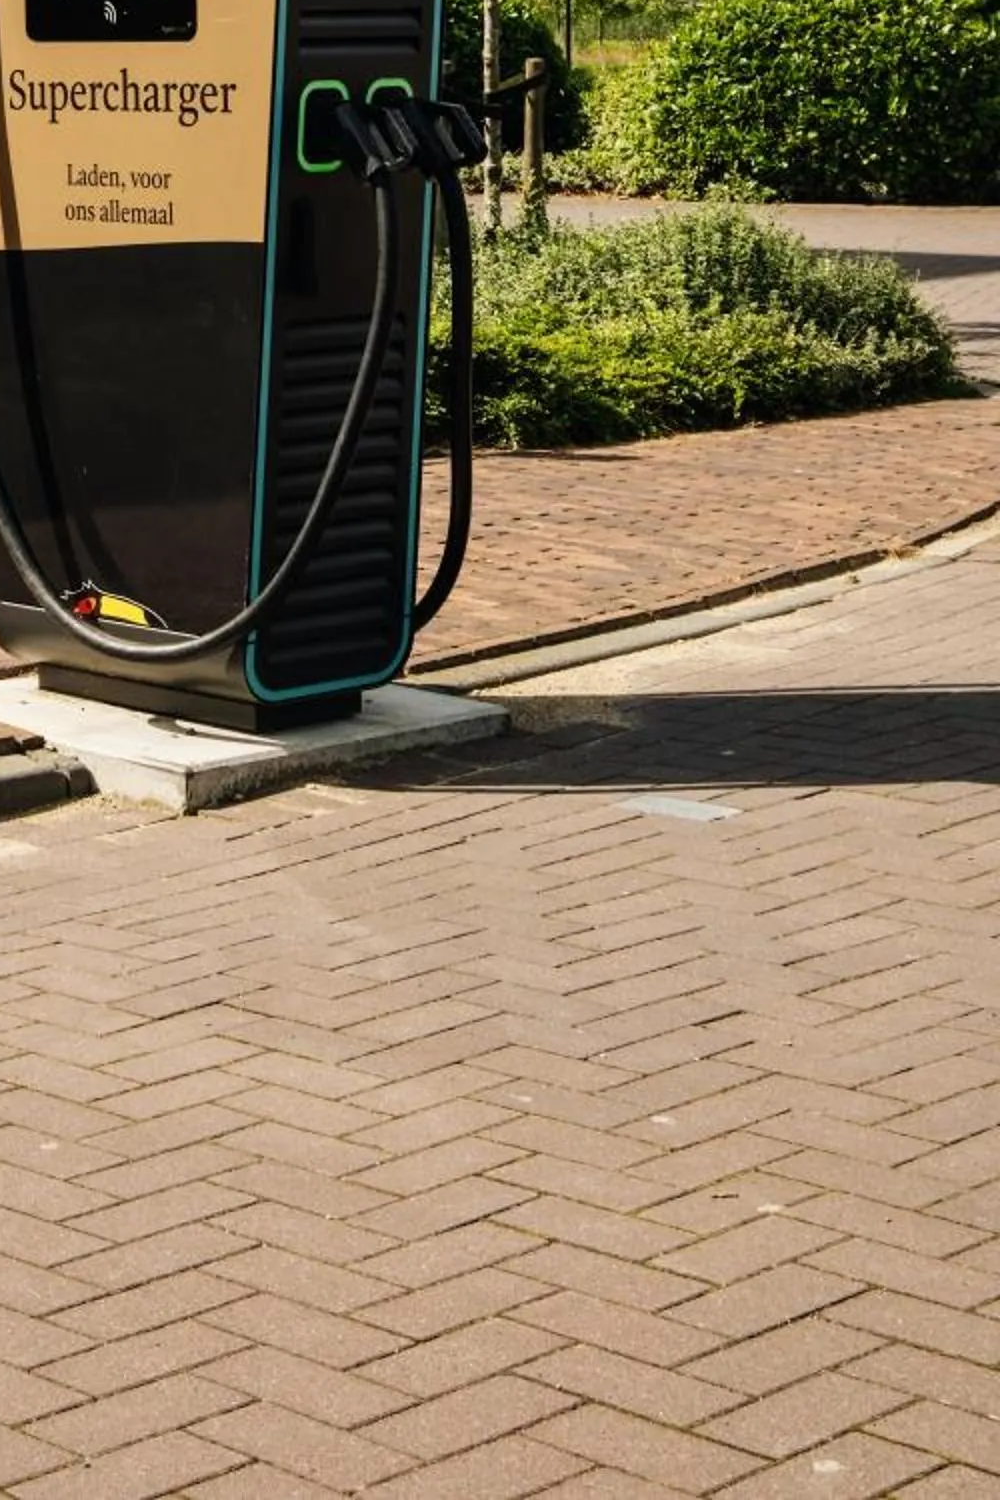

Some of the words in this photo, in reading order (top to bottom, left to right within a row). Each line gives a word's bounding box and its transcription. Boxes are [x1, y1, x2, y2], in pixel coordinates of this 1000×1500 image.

[9, 67, 237, 127] Supercharger
[67, 163, 126, 192] Laden,
[130, 169, 172, 190] voor
[65, 202, 95, 221] ons
[99, 199, 174, 226] allemaal
